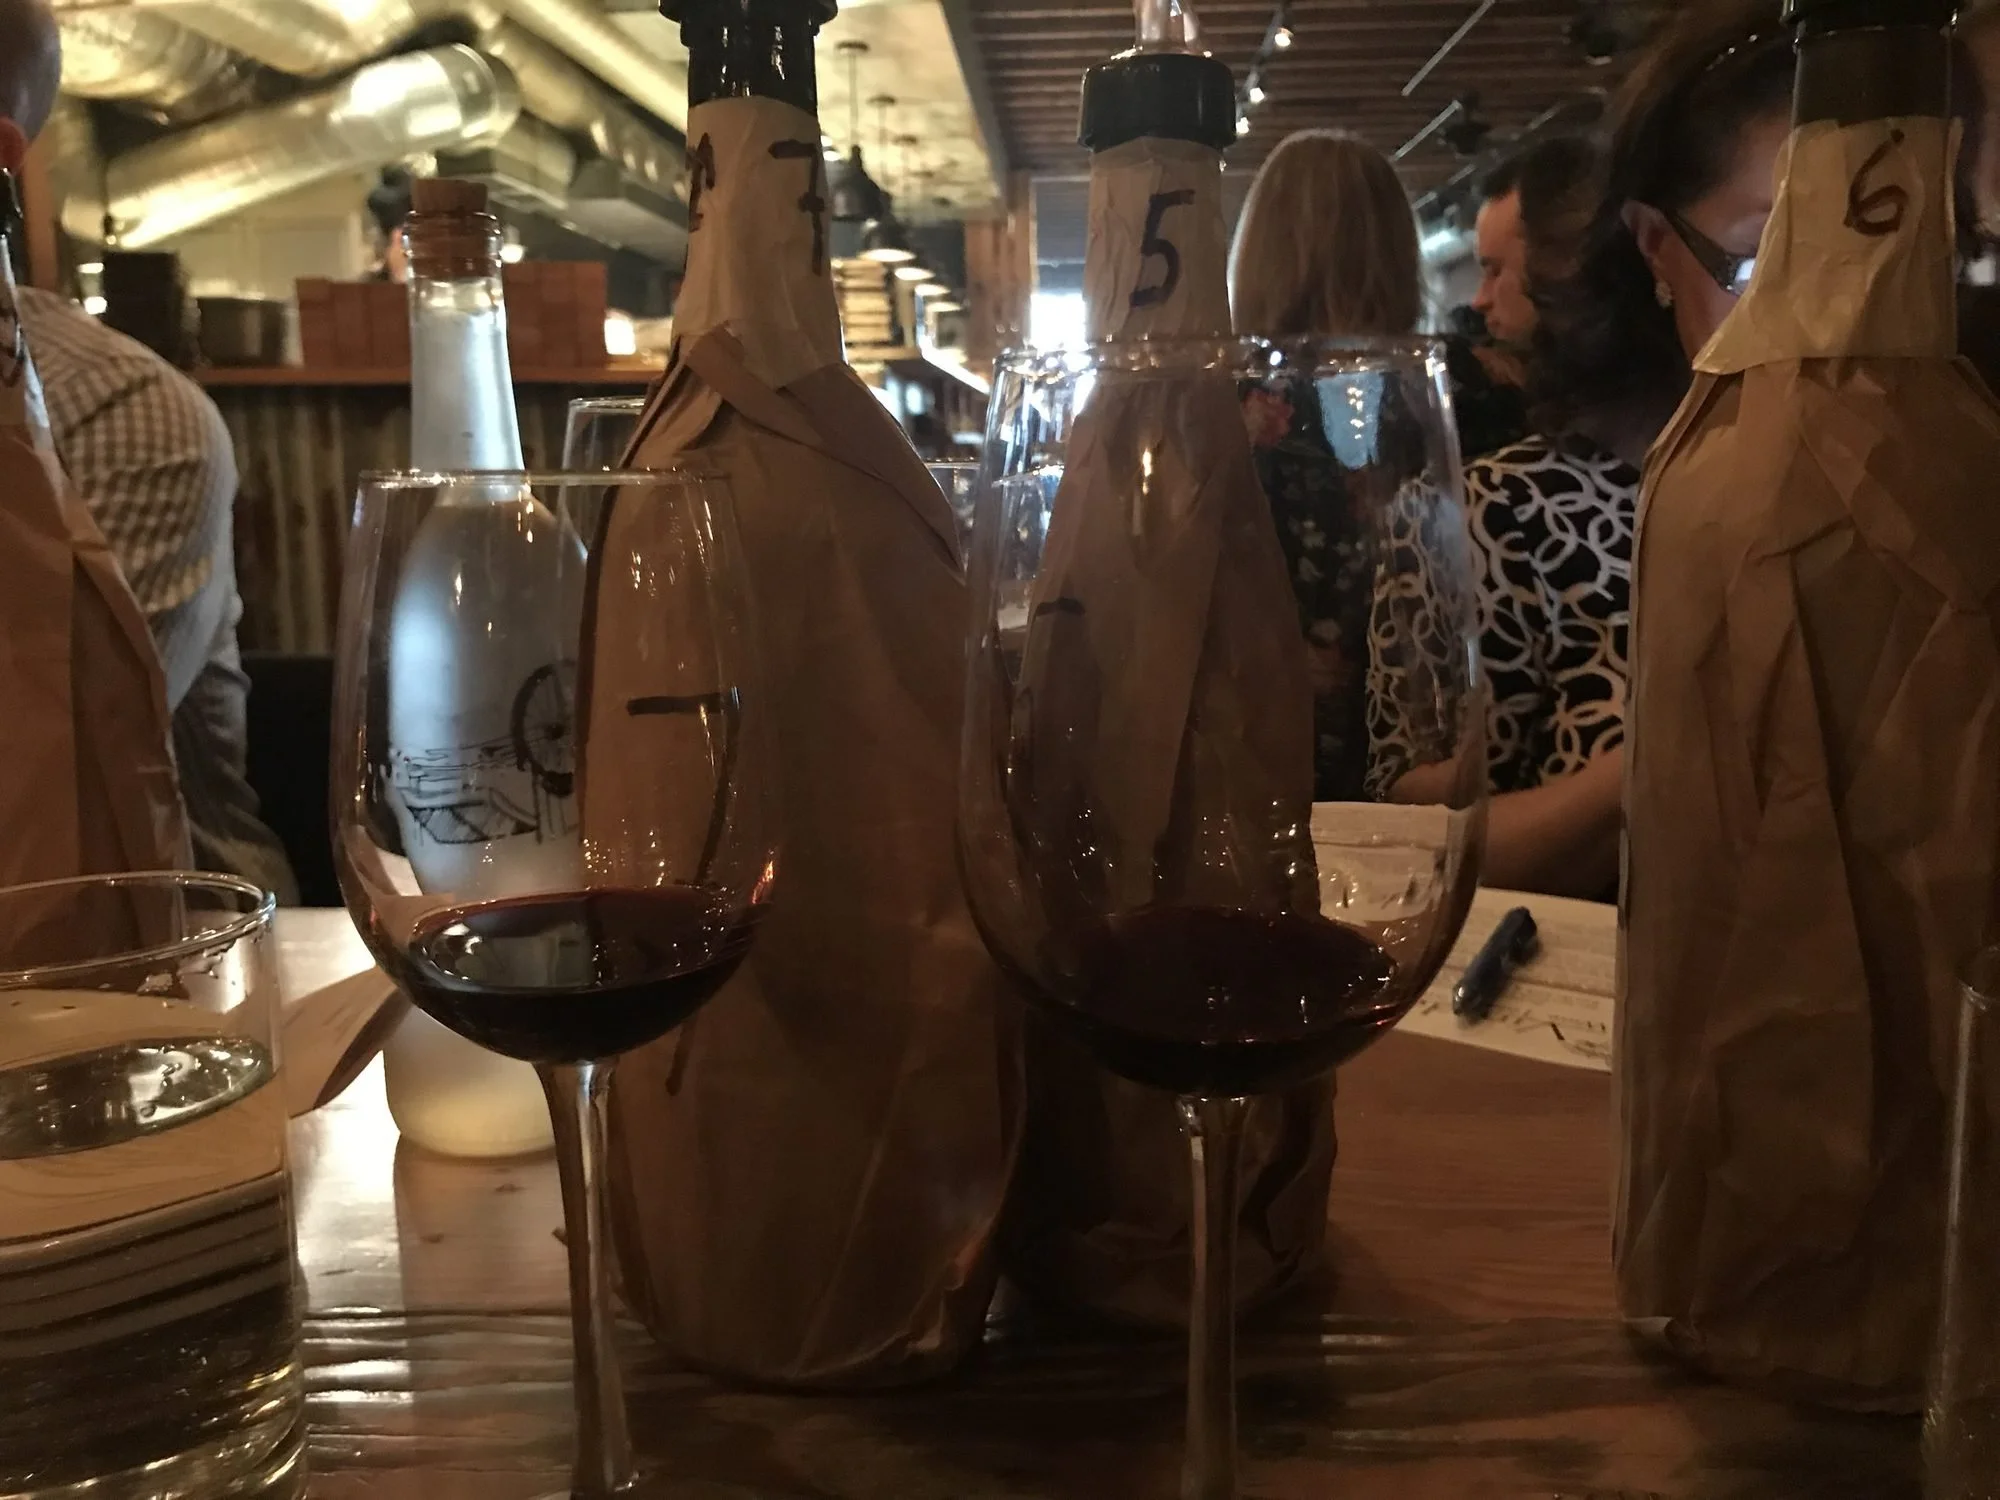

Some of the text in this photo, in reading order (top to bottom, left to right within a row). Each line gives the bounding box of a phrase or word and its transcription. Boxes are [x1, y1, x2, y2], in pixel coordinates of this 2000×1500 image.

[767, 138, 826, 278] 7
[1844, 129, 1909, 237] 6
[1131, 188, 1195, 308] 5
